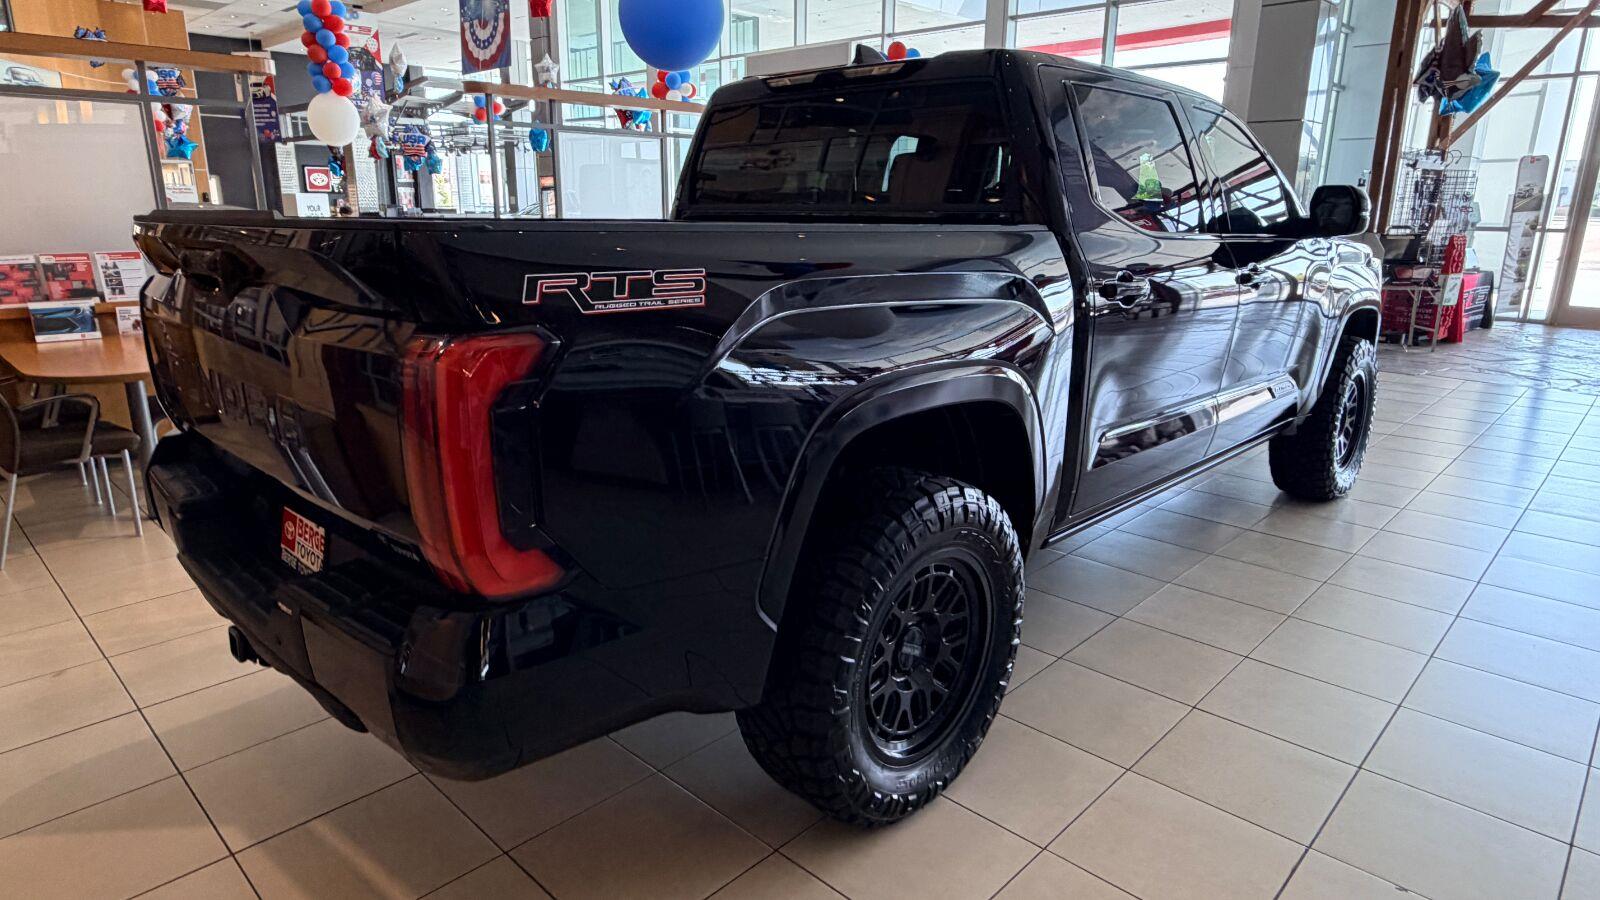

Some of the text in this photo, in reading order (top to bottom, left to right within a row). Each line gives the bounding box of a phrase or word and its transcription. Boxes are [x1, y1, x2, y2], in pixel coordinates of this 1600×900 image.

[522, 268, 706, 312] RTS
[594, 302, 637, 310] RUGGED
[667, 297, 701, 305] SERIES
[297, 517, 325, 553] BERGE
